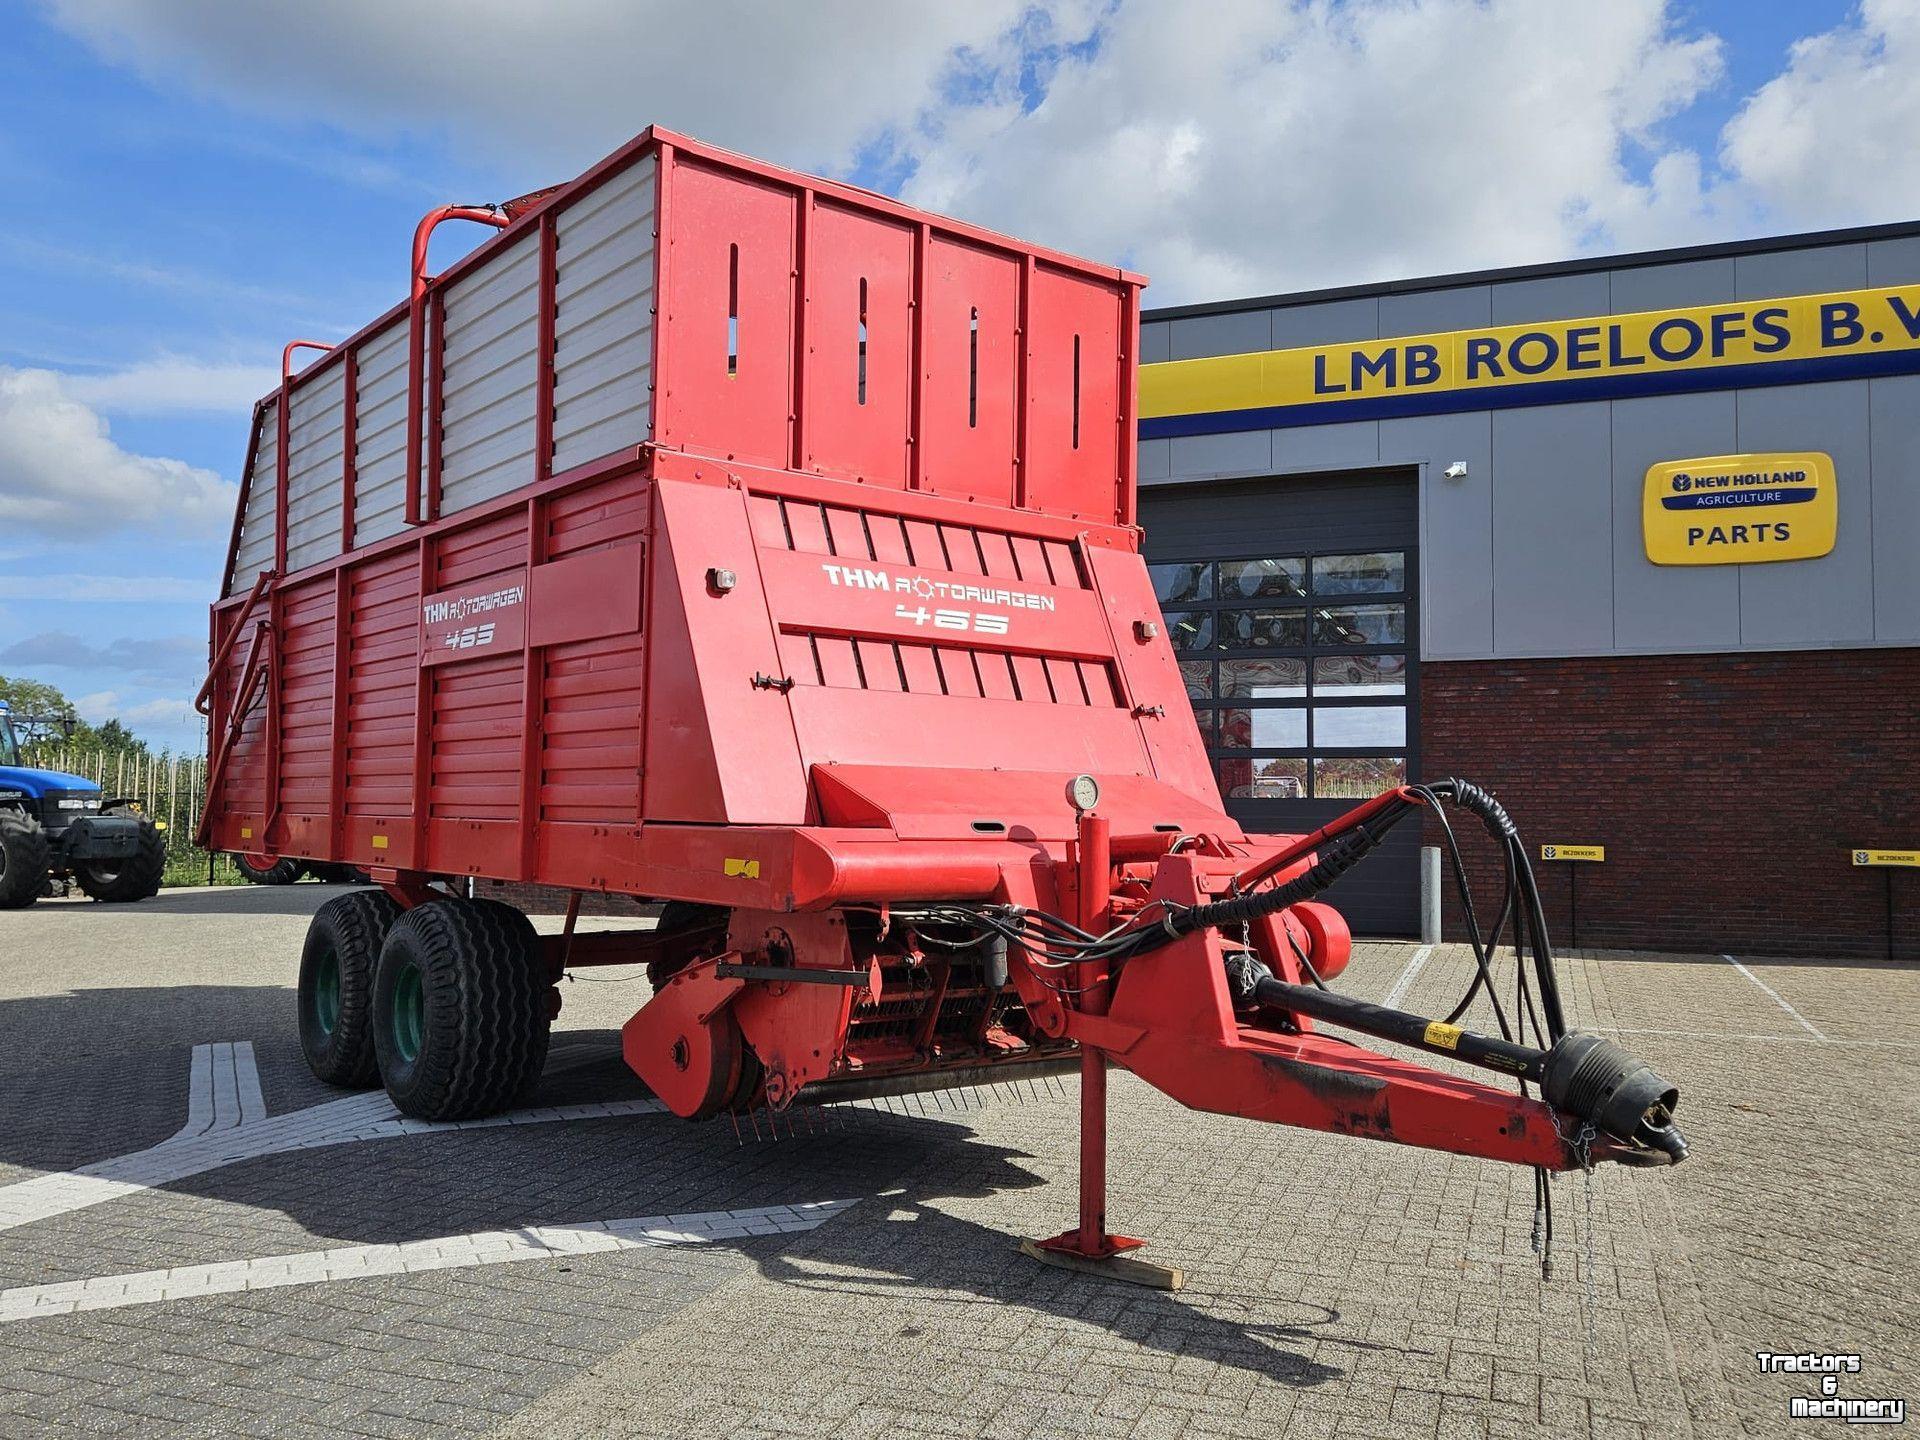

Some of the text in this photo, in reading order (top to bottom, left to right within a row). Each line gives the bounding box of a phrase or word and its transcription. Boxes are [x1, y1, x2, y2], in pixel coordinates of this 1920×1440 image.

[1314, 344, 1442, 395] LMB
[1466, 308, 1792, 380] ROELOFS
[1695, 471, 1806, 489] NEW HOLLAND
[1696, 492, 1782, 506] AGRICULTURE
[1688, 522, 1791, 546] PARTS
[822, 564, 1056, 612] THM ROTORWAGEN
[423, 601, 448, 625] THM
[894, 604, 1010, 635] 465
[445, 622, 496, 651] 465
